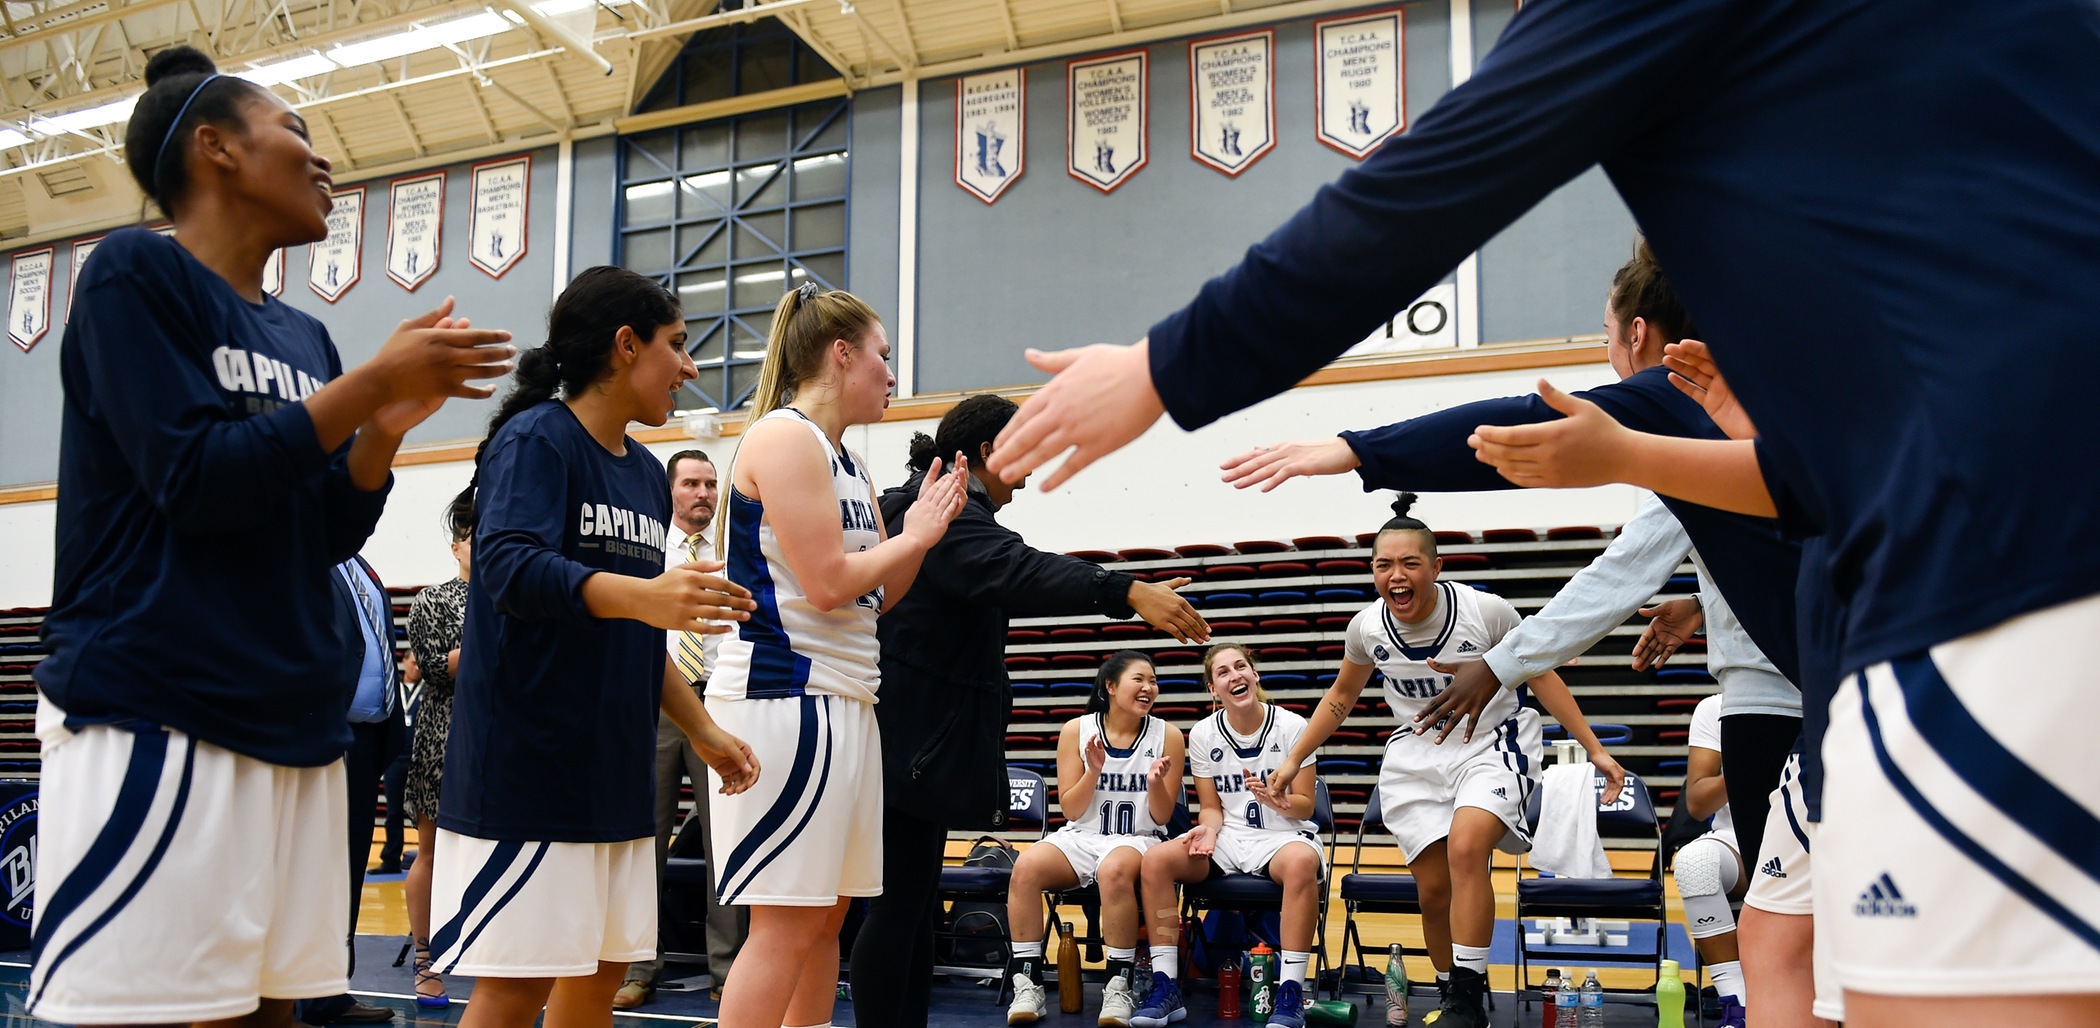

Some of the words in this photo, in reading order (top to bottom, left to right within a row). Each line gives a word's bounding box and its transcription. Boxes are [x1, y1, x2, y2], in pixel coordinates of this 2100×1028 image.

[1327, 41, 1391, 58] CHAMPIONS
[1201, 53, 1262, 70] CHAMPIONS
[1343, 55, 1376, 66] MEN'S
[1208, 65, 1256, 80] WOMEN'S
[1341, 66, 1377, 78] RUGBY
[1078, 73, 1136, 90] CHAMPIONS
[1211, 75, 1253, 88] SOCCER
[966, 91, 1015, 106] AGGREGATE
[1084, 85, 1131, 99] WOMEN'S
[1217, 88, 1248, 100] MEN'S
[1078, 93, 1136, 107] VOLLEYBALL
[1212, 94, 1254, 107] SOCCER
[1084, 104, 1131, 118] WOMEN'S
[1087, 114, 1128, 127] SOCCER
[479, 182, 521, 196] CHAMPIONS
[397, 191, 437, 205] CHAMPIONS
[489, 193, 511, 202] MEN'S
[396, 208, 435, 219] VOLLEYBALL
[477, 201, 519, 213] BASKETBALL
[402, 225, 428, 236] SOCCER
[15, 268, 47, 280] CHAMPIONS
[20, 285, 41, 295] SOCCER
[1099, 799, 1137, 836] 10
[1761, 865, 1788, 880] adidas
[1854, 901, 1919, 918] adidas
[1250, 965, 1264, 983] G
